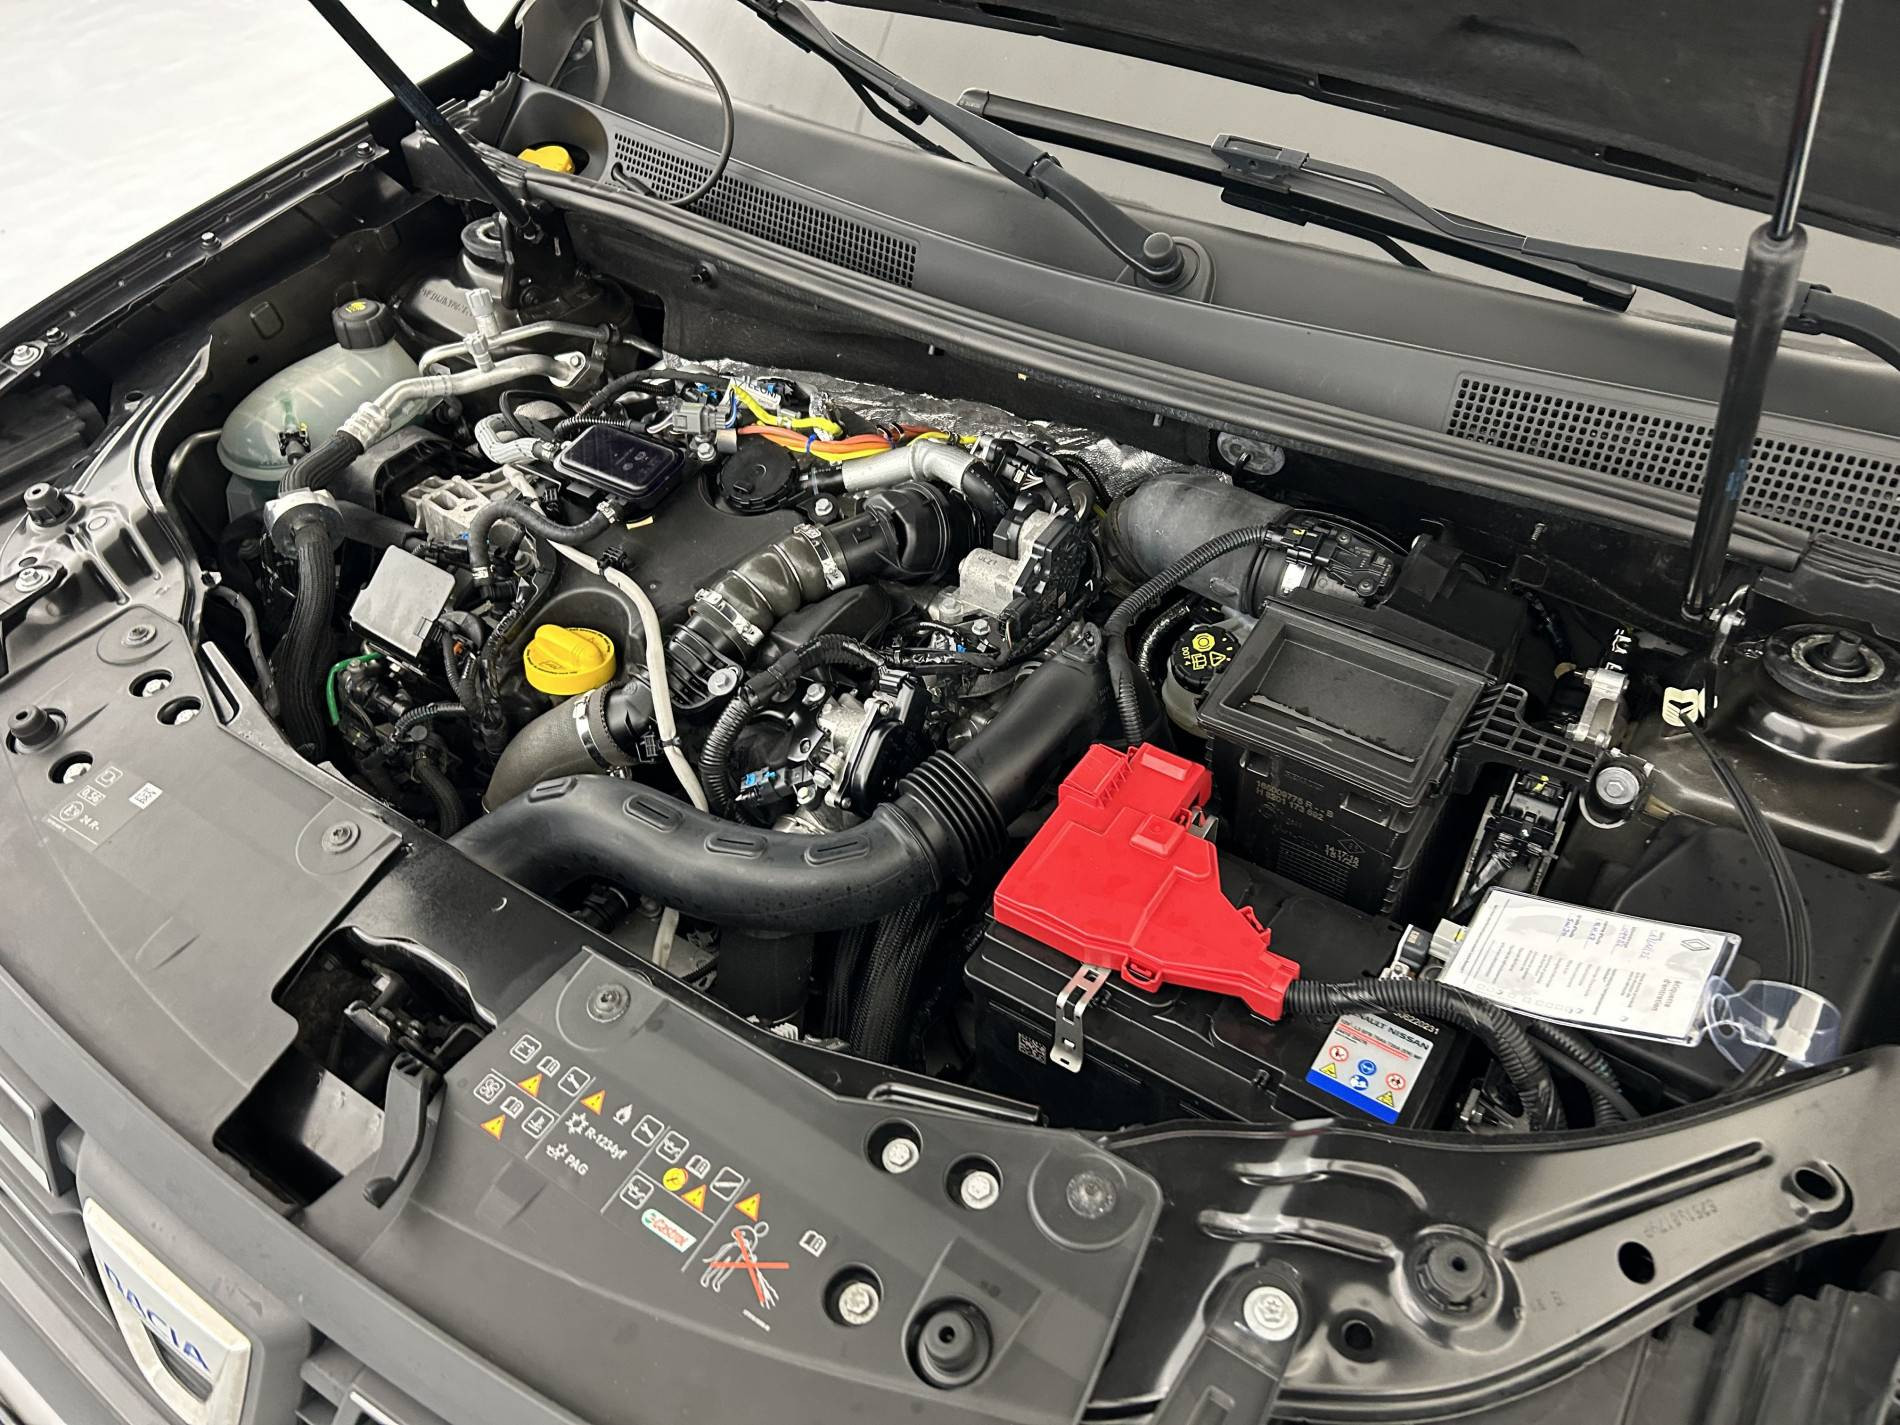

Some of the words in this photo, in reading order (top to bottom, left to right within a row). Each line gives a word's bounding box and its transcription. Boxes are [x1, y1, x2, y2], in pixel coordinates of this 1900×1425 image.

[1182, 647, 1190, 660] DOT
[1388, 1026, 1430, 1051] NISSAN
[584, 1127, 628, 1160] R-1234yf
[564, 1154, 589, 1176] PAG
[103, 1262, 211, 1373] DACIA
